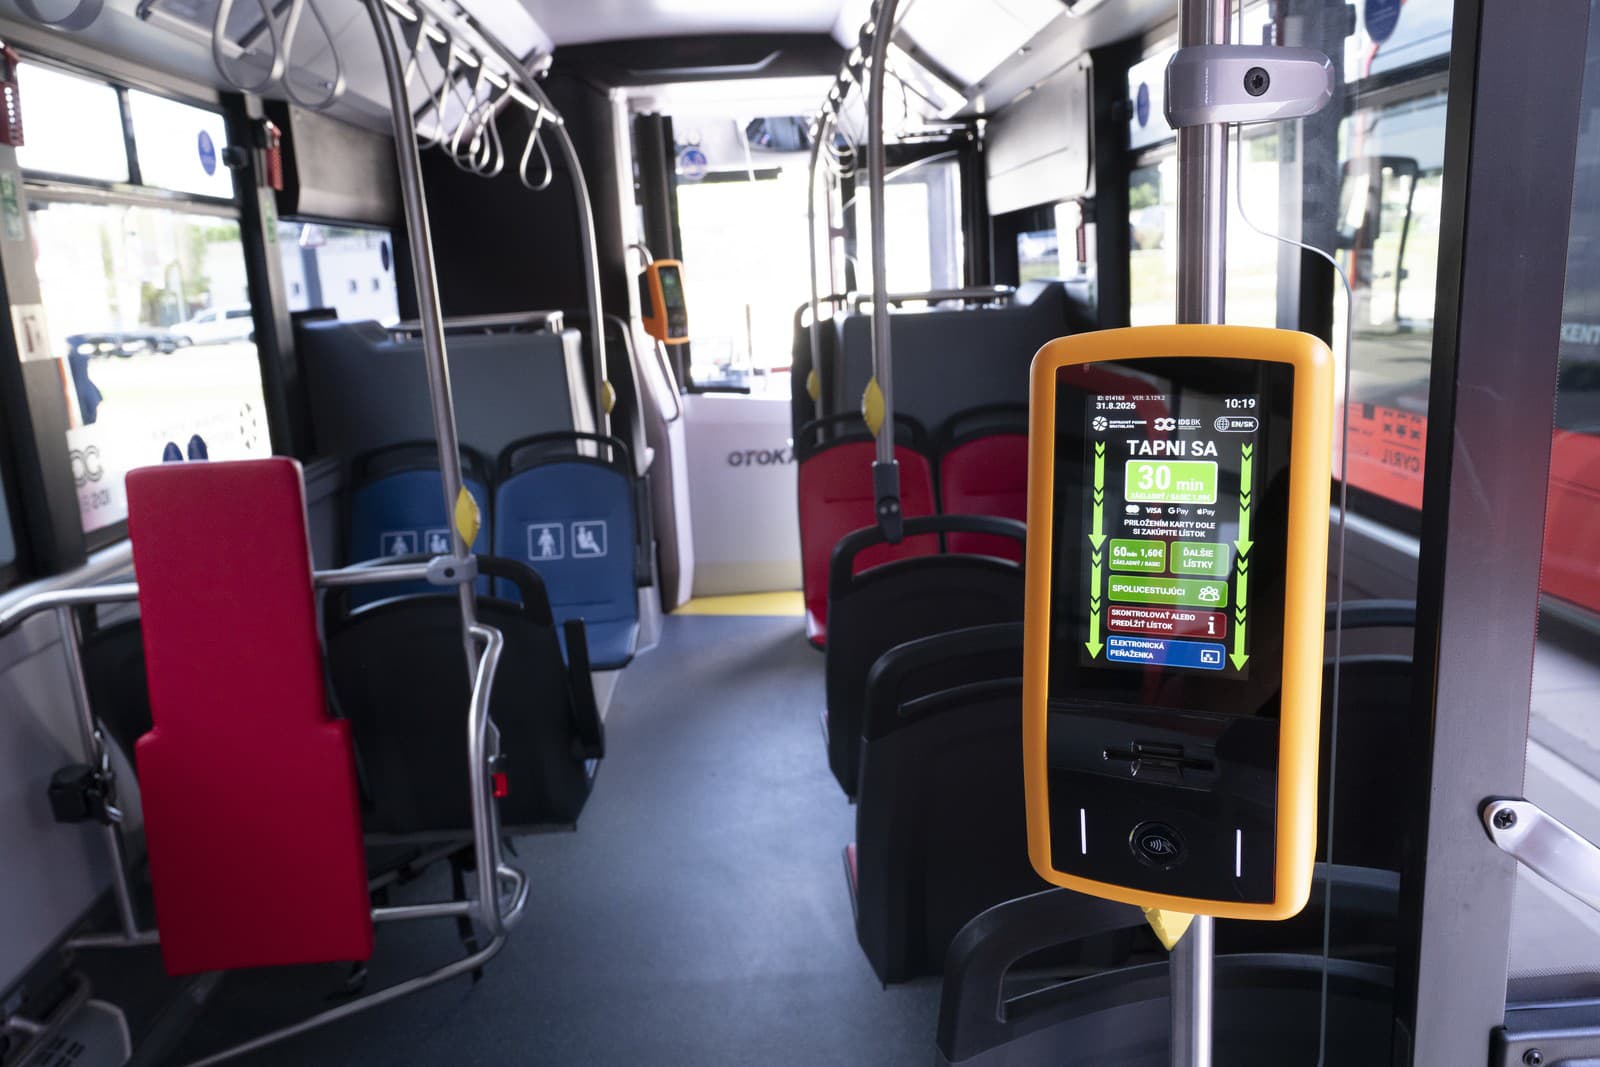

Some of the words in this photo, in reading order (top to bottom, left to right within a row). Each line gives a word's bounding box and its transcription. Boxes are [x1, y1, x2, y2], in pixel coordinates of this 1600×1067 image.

[1095, 402, 1137, 410] 31.8.2026
[1224, 398, 1256, 409] 10:19
[1231, 420, 1254, 428] EN/SK
[1126, 439, 1185, 456] TAPNI
[1190, 440, 1218, 457] SA
[727, 449, 797, 467] OTOK
[1137, 464, 1171, 490] 30
[1176, 478, 1204, 491] min
[1145, 506, 1162, 514] VISA
[1124, 518, 1169, 528] PRILOŽENÍM
[1169, 521, 1194, 529] KARTY
[1142, 527, 1178, 537] ZAKÚPITE
[1179, 528, 1206, 538] LÍSTOK
[1140, 549, 1163, 558] 1,60€
[1183, 547, 1214, 558] ĎALŠIE
[1183, 558, 1214, 569] LÍSTKY
[1112, 584, 1186, 597] SPOLUCESTUJÚCI
[1111, 609, 1170, 620] SKONTROLOVAŤ
[1170, 613, 1196, 621] ALEBO
[1146, 620, 1173, 630] LÍSTOK
[1110, 639, 1165, 650] ELEKTRONICKÁ
